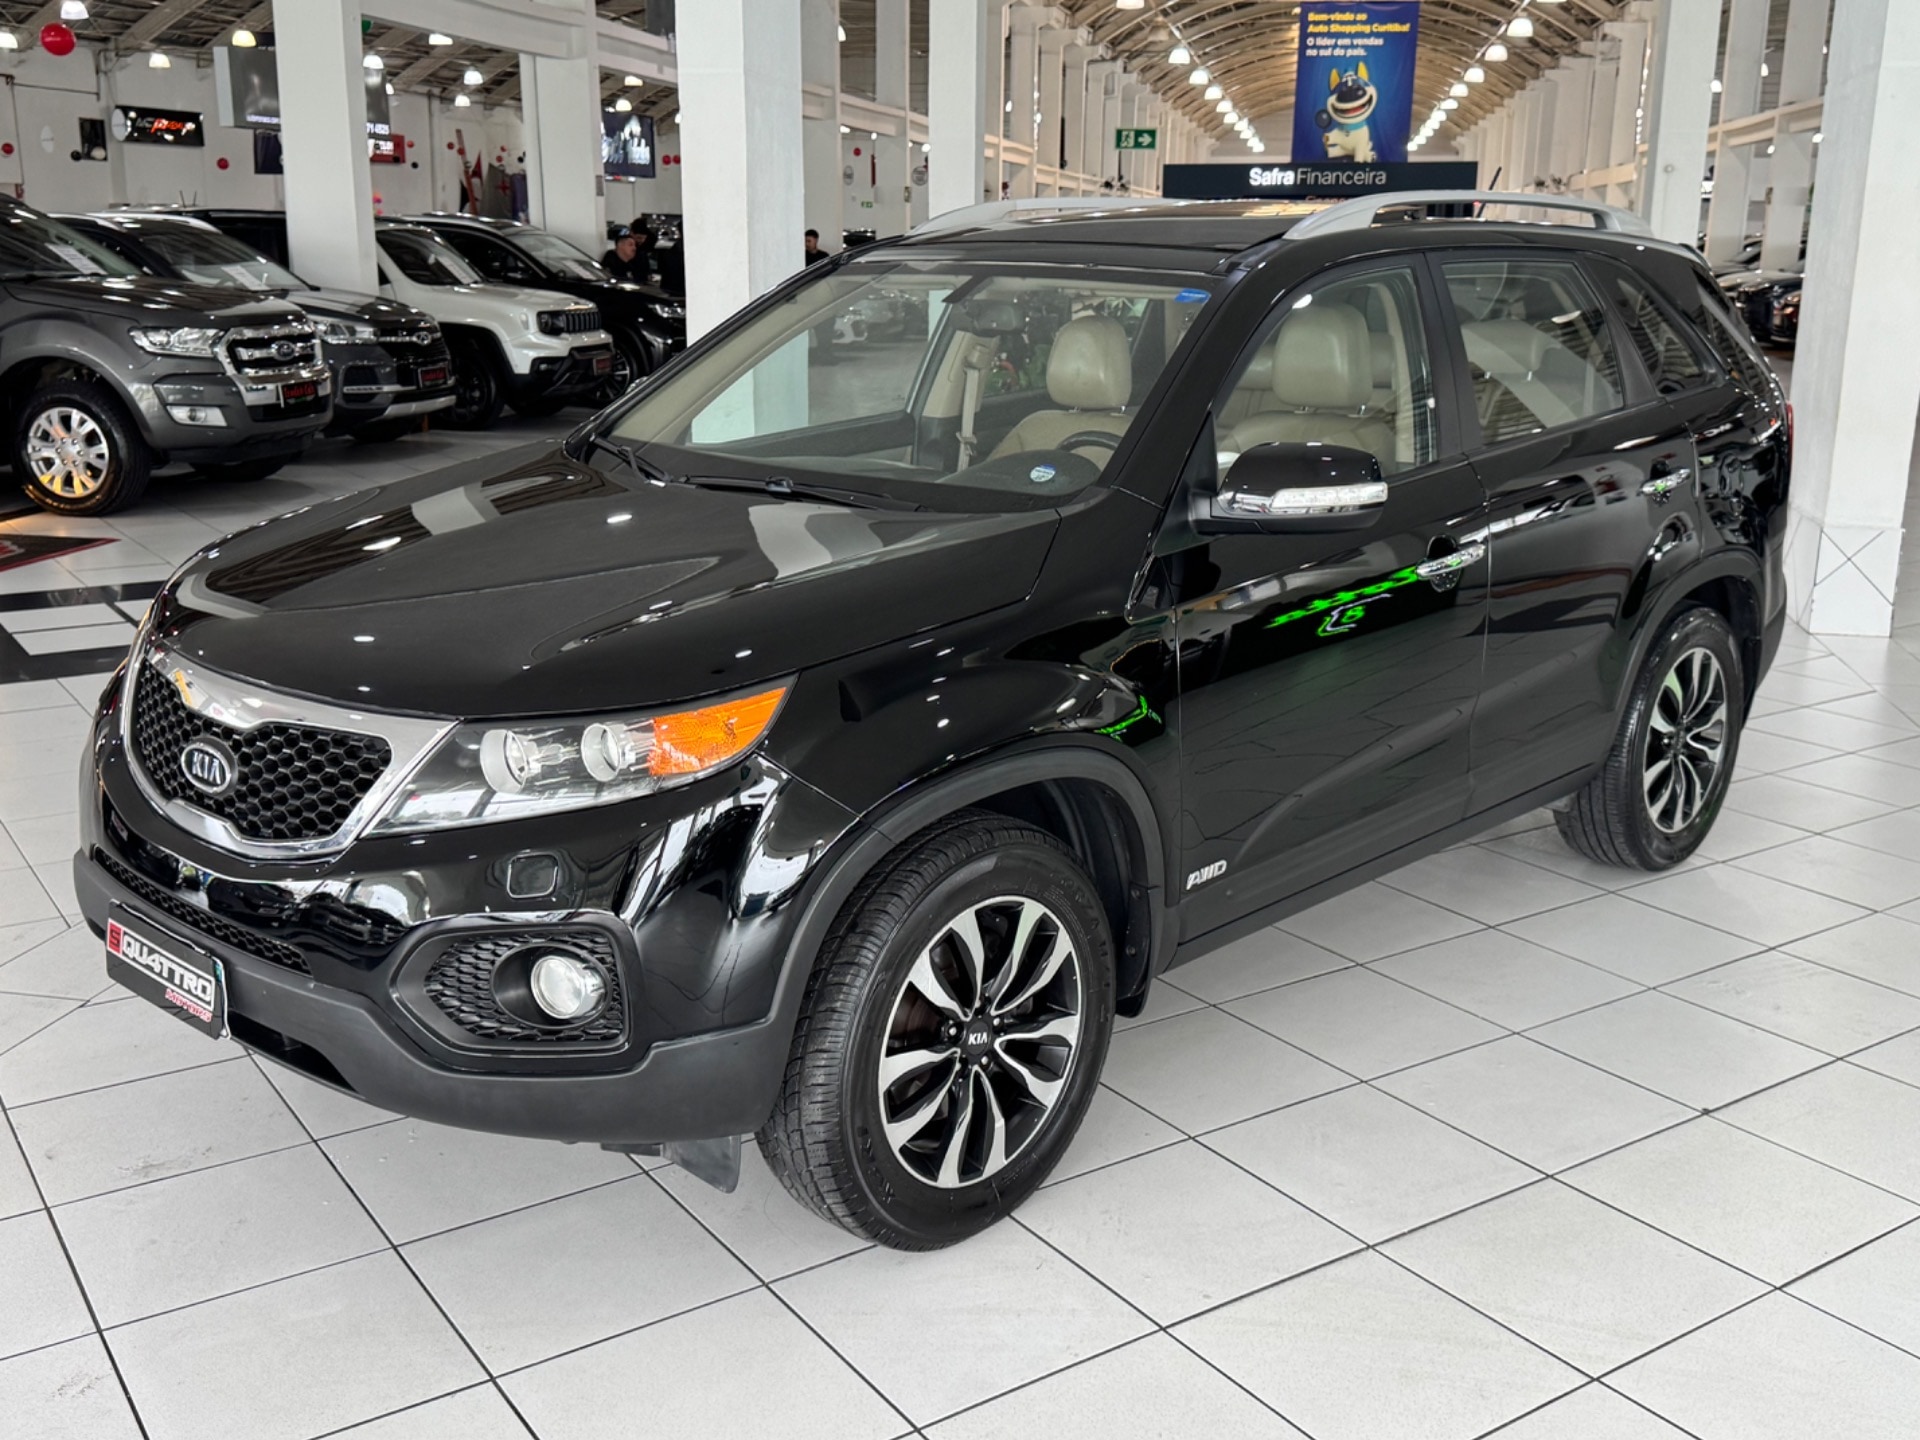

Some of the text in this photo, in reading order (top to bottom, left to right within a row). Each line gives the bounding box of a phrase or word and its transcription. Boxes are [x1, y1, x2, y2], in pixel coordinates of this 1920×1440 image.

[1307, 11, 1369, 22] Bem-vindo ao
[1307, 22, 1411, 34] Auto Shopping Curitiba!
[1306, 37, 1315, 46] O
[1336, 38, 1351, 46] em
[1352, 36, 1384, 46] vendas
[1305, 48, 1318, 56] no
[1319, 47, 1332, 56] sul
[1332, 47, 1345, 56] do
[1249, 167, 1386, 186] Safra Financeira
[191, 750, 221, 785] KIA
[1186, 859, 1227, 891] AWD
[968, 1031, 988, 1046] KIA
